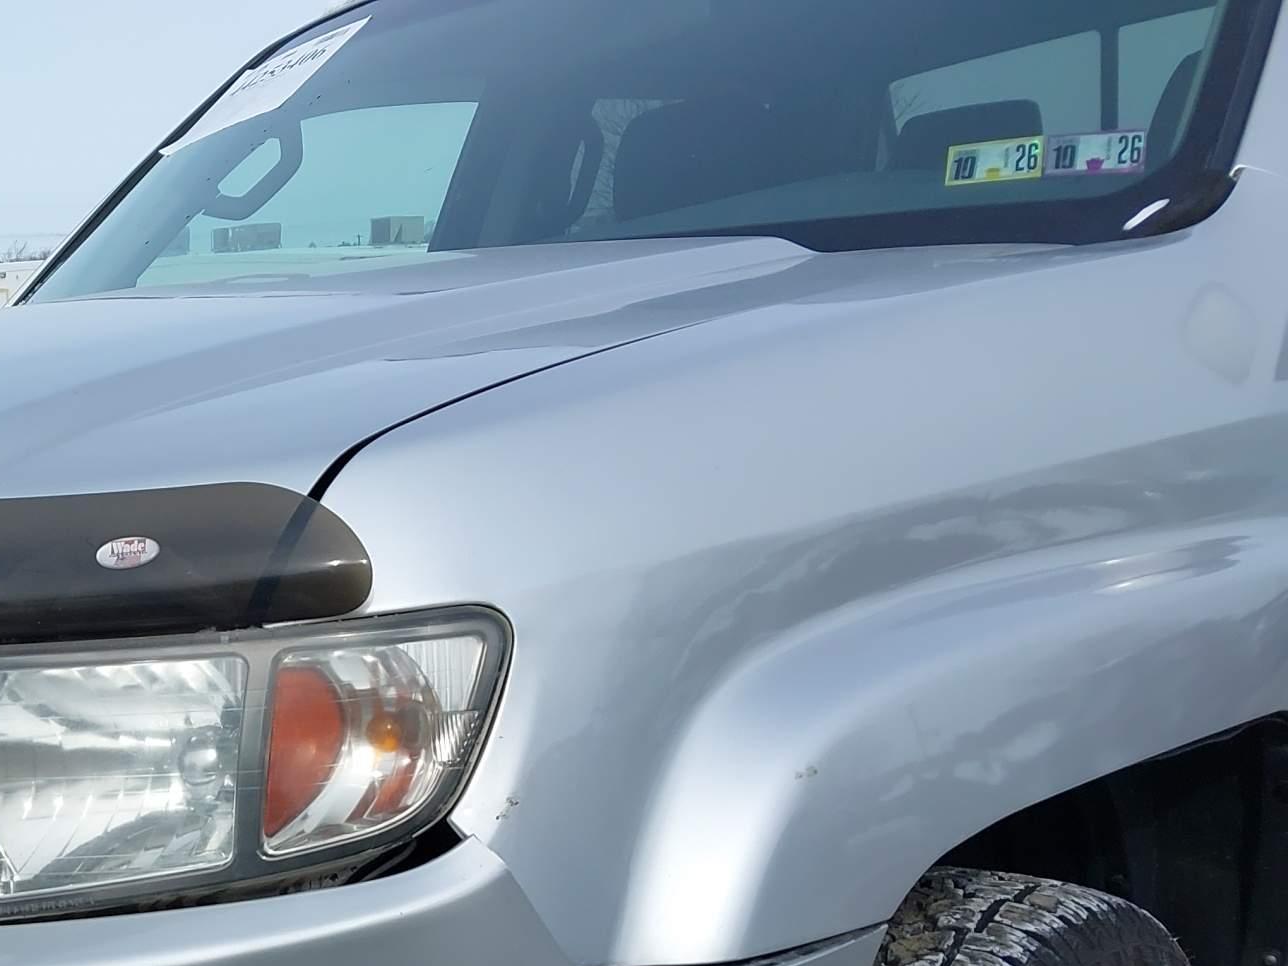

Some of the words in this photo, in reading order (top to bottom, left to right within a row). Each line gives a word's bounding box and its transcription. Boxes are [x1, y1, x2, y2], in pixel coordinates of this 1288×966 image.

[954, 155, 977, 180] 10
[1015, 142, 1039, 172] 26
[1053, 144, 1076, 169] 10
[1117, 134, 1142, 165] 26
